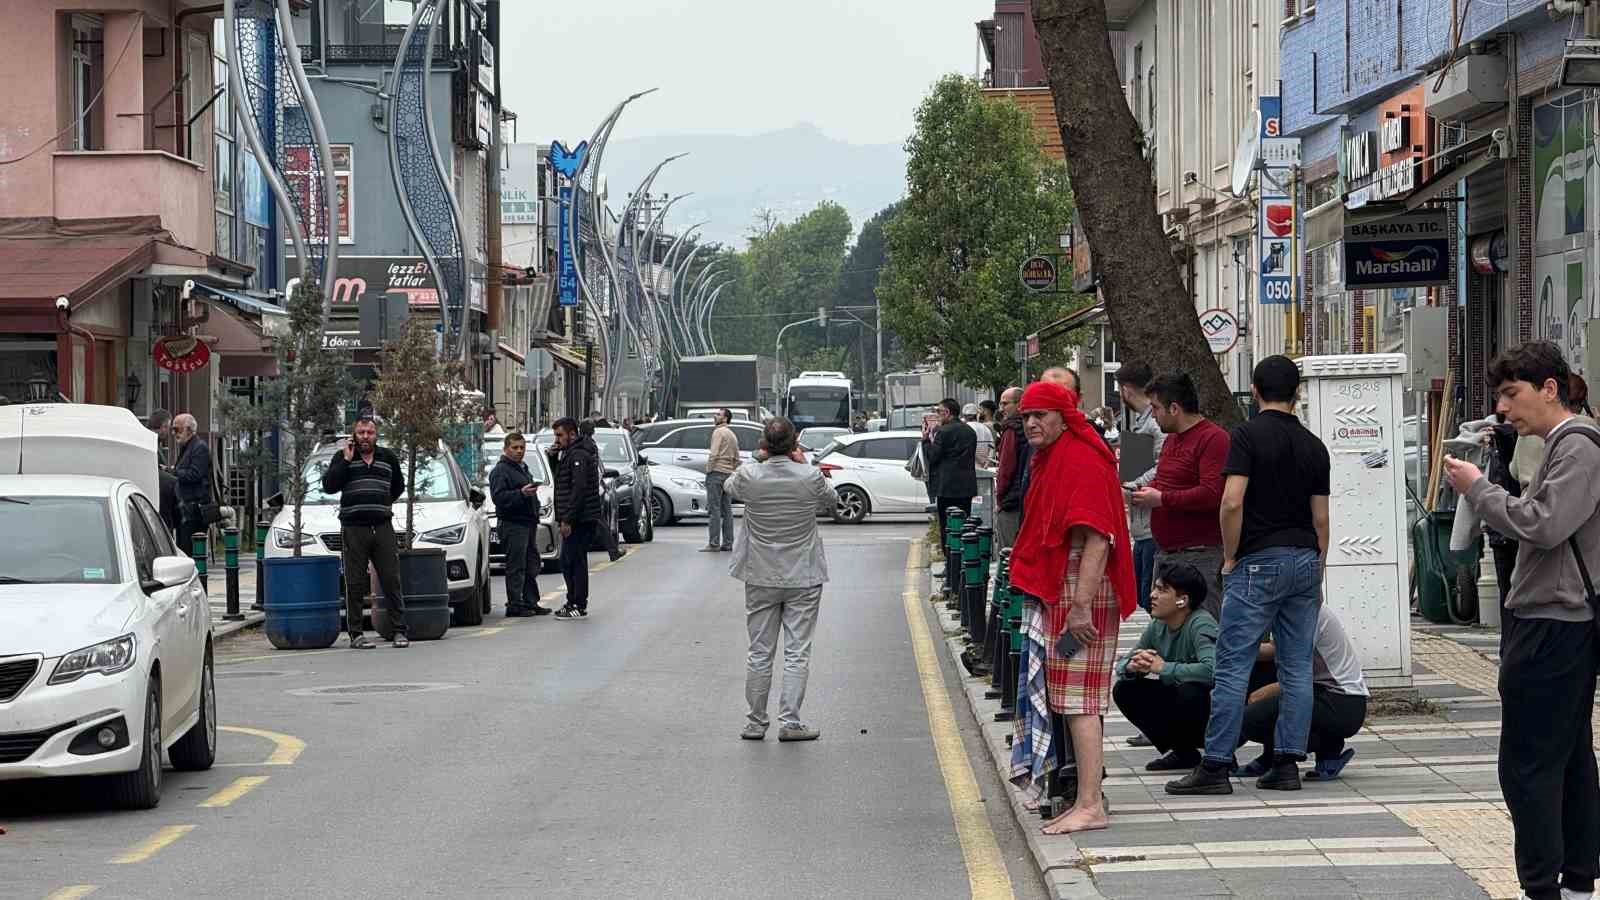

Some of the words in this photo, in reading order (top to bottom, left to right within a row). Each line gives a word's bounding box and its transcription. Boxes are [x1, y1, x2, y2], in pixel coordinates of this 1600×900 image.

[1346, 129, 1370, 183] YONCA
[1351, 223, 1414, 237] BAŞKAYA
[1355, 257, 1431, 275] Marshall
[388, 275, 426, 287] tatlar
